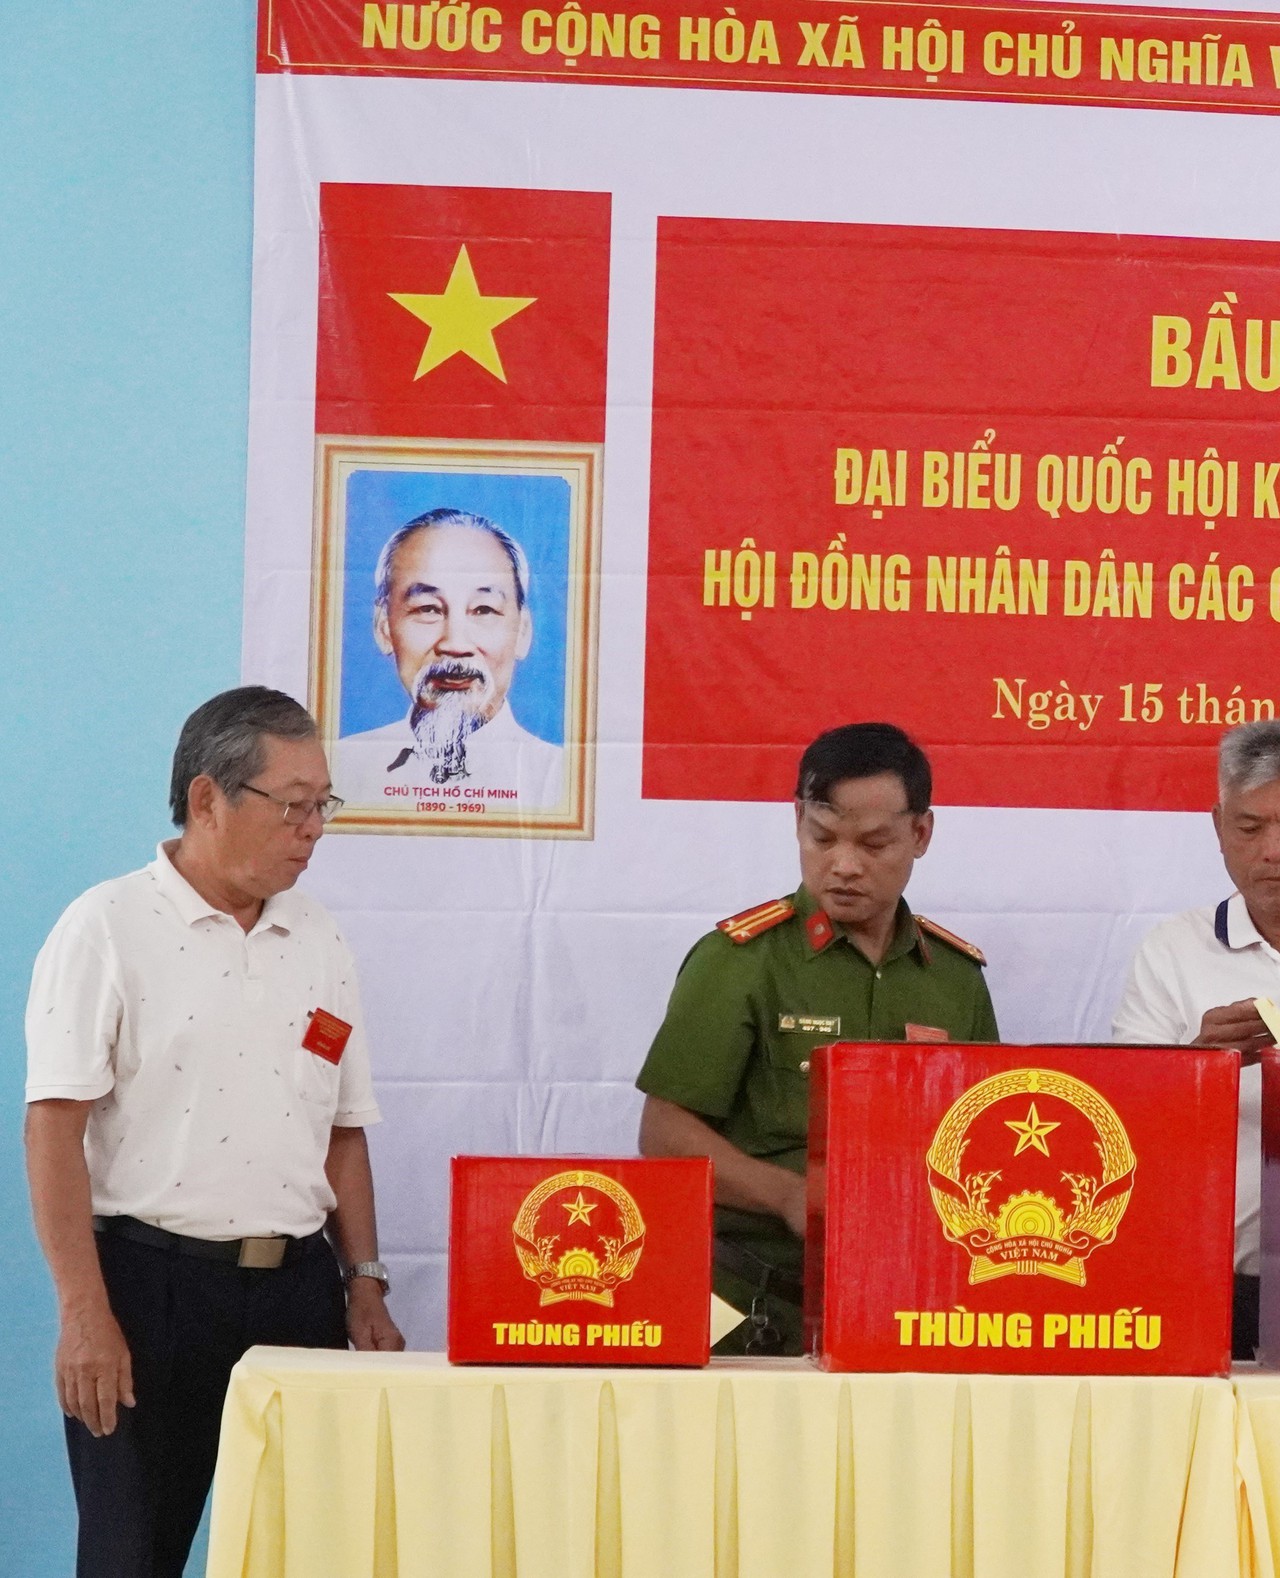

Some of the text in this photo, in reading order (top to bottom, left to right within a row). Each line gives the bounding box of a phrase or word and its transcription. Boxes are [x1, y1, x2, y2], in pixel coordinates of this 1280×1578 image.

[362, 0, 502, 53] NƯỚC
[521, 2, 660, 65] CỘNG
[680, 7, 780, 64] HÒA
[797, 15, 865, 68] XÃ
[883, 19, 964, 82] HỘI
[984, 20, 1081, 79] CHỦ
[1100, 34, 1253, 87] NGHĨA
[834, 448, 907, 519] ĐẠI
[923, 430, 1021, 510] BIỂU
[1037, 436, 1152, 518] QUỐC
[1168, 448, 1238, 529] HỘI
[704, 538, 776, 620] HỘI
[790, 533, 910, 611] ĐỒNG
[926, 545, 1048, 615] NHÂN
[1064, 549, 1153, 618] DÂN
[1169, 552, 1254, 622] CÁC
[993, 678, 1103, 730] Ngày
[1120, 683, 1163, 722] 15
[384, 784, 409, 796] CHỦ
[412, 787, 440, 799] TỊCH
[464, 787, 485, 798] CHÍ
[487, 789, 518, 798] MINH
[416, 802, 446, 812] (1890
[456, 803, 485, 813] 1969)
[1000, 1247, 1058, 1262] VIỆT NAM
[493, 1320, 661, 1347] THÙNG PHIẾU
[894, 1306, 1161, 1349] THÙNG PHIẾU
